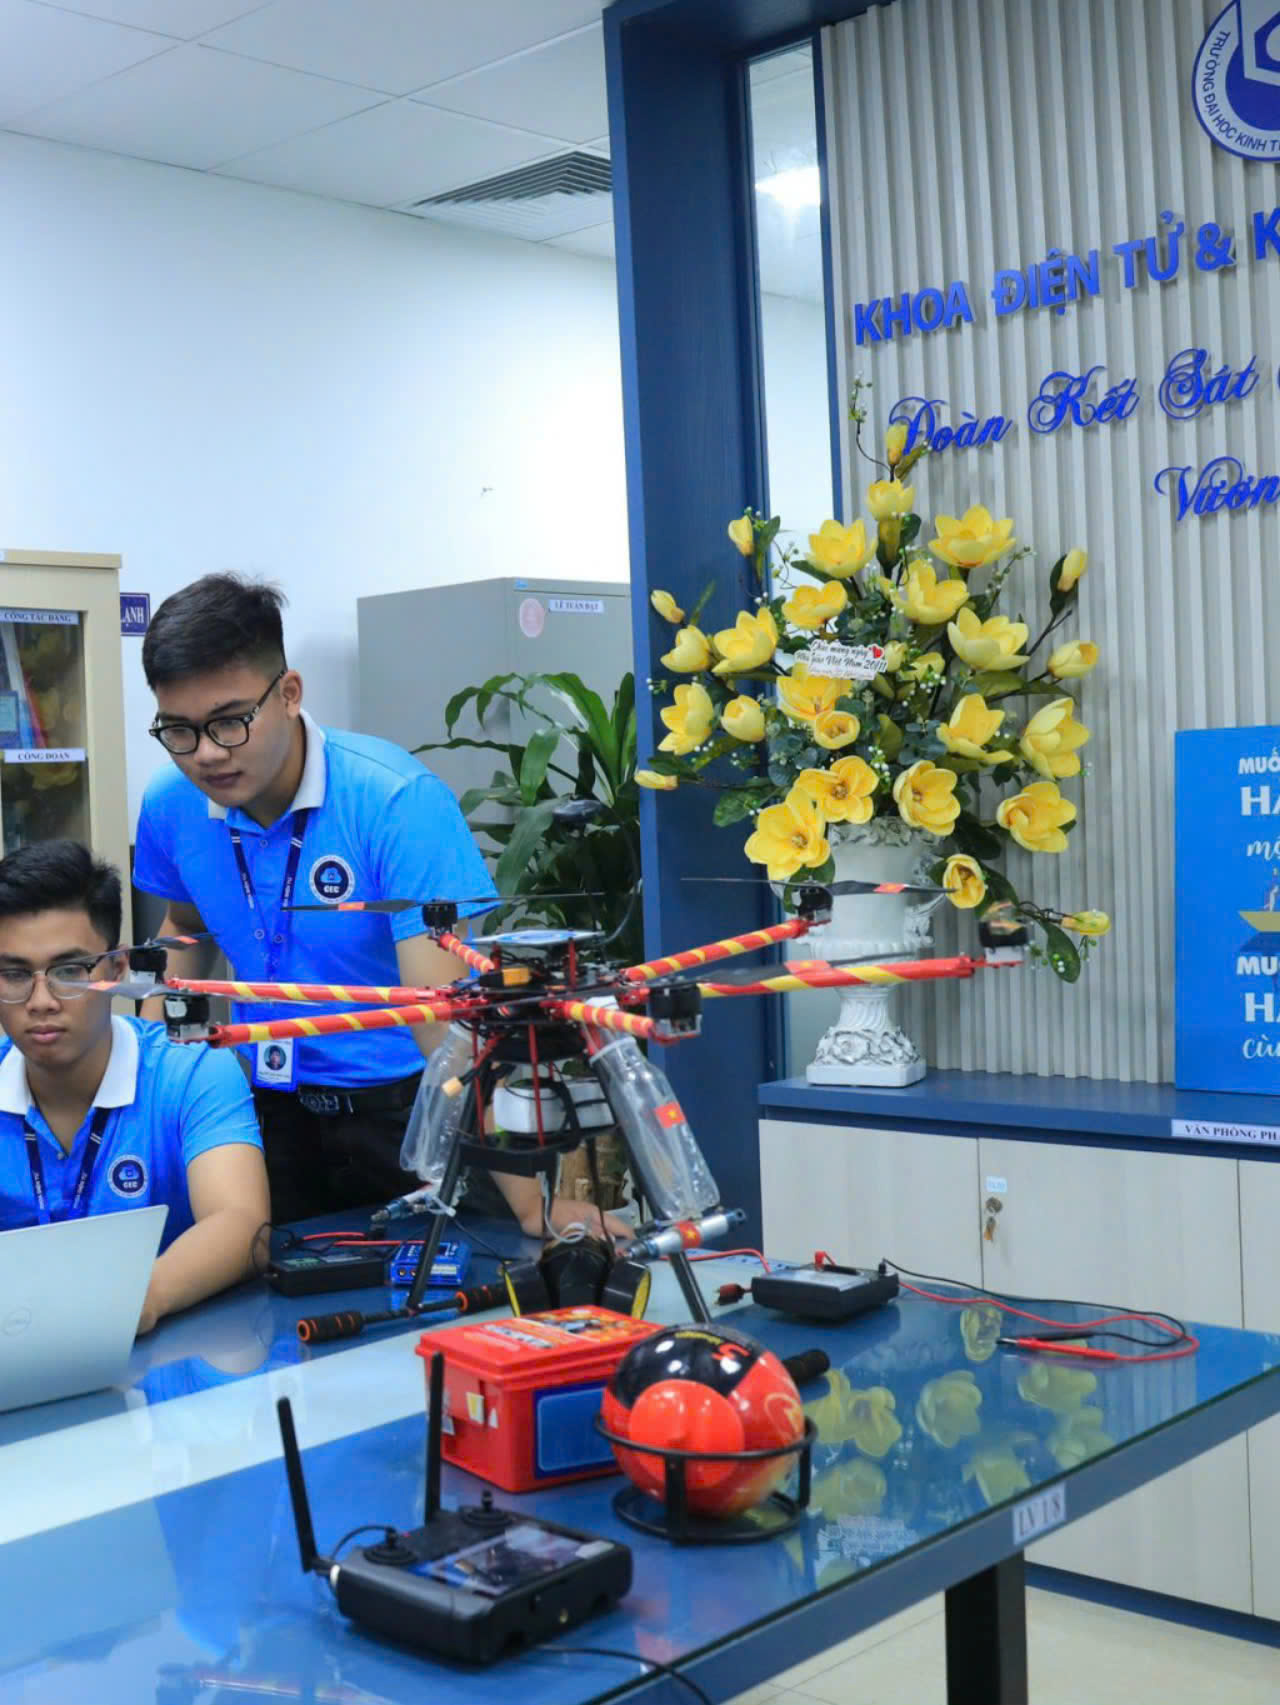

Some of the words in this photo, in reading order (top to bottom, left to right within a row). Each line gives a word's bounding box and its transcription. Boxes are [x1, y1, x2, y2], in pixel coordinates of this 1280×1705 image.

[1212, 115, 1237, 139] HỌC
[1235, 132, 1267, 152] KINH
[854, 280, 974, 346] KHOA
[991, 247, 1101, 316] ĐIỆN
[1113, 210, 1186, 289] TỬ
[1196, 222, 1235, 272] &
[888, 396, 1013, 456] Đoàn
[1028, 365, 1141, 434] Kết
[1159, 348, 1260, 420] Sát
[1154, 456, 1280, 522] Vươn
